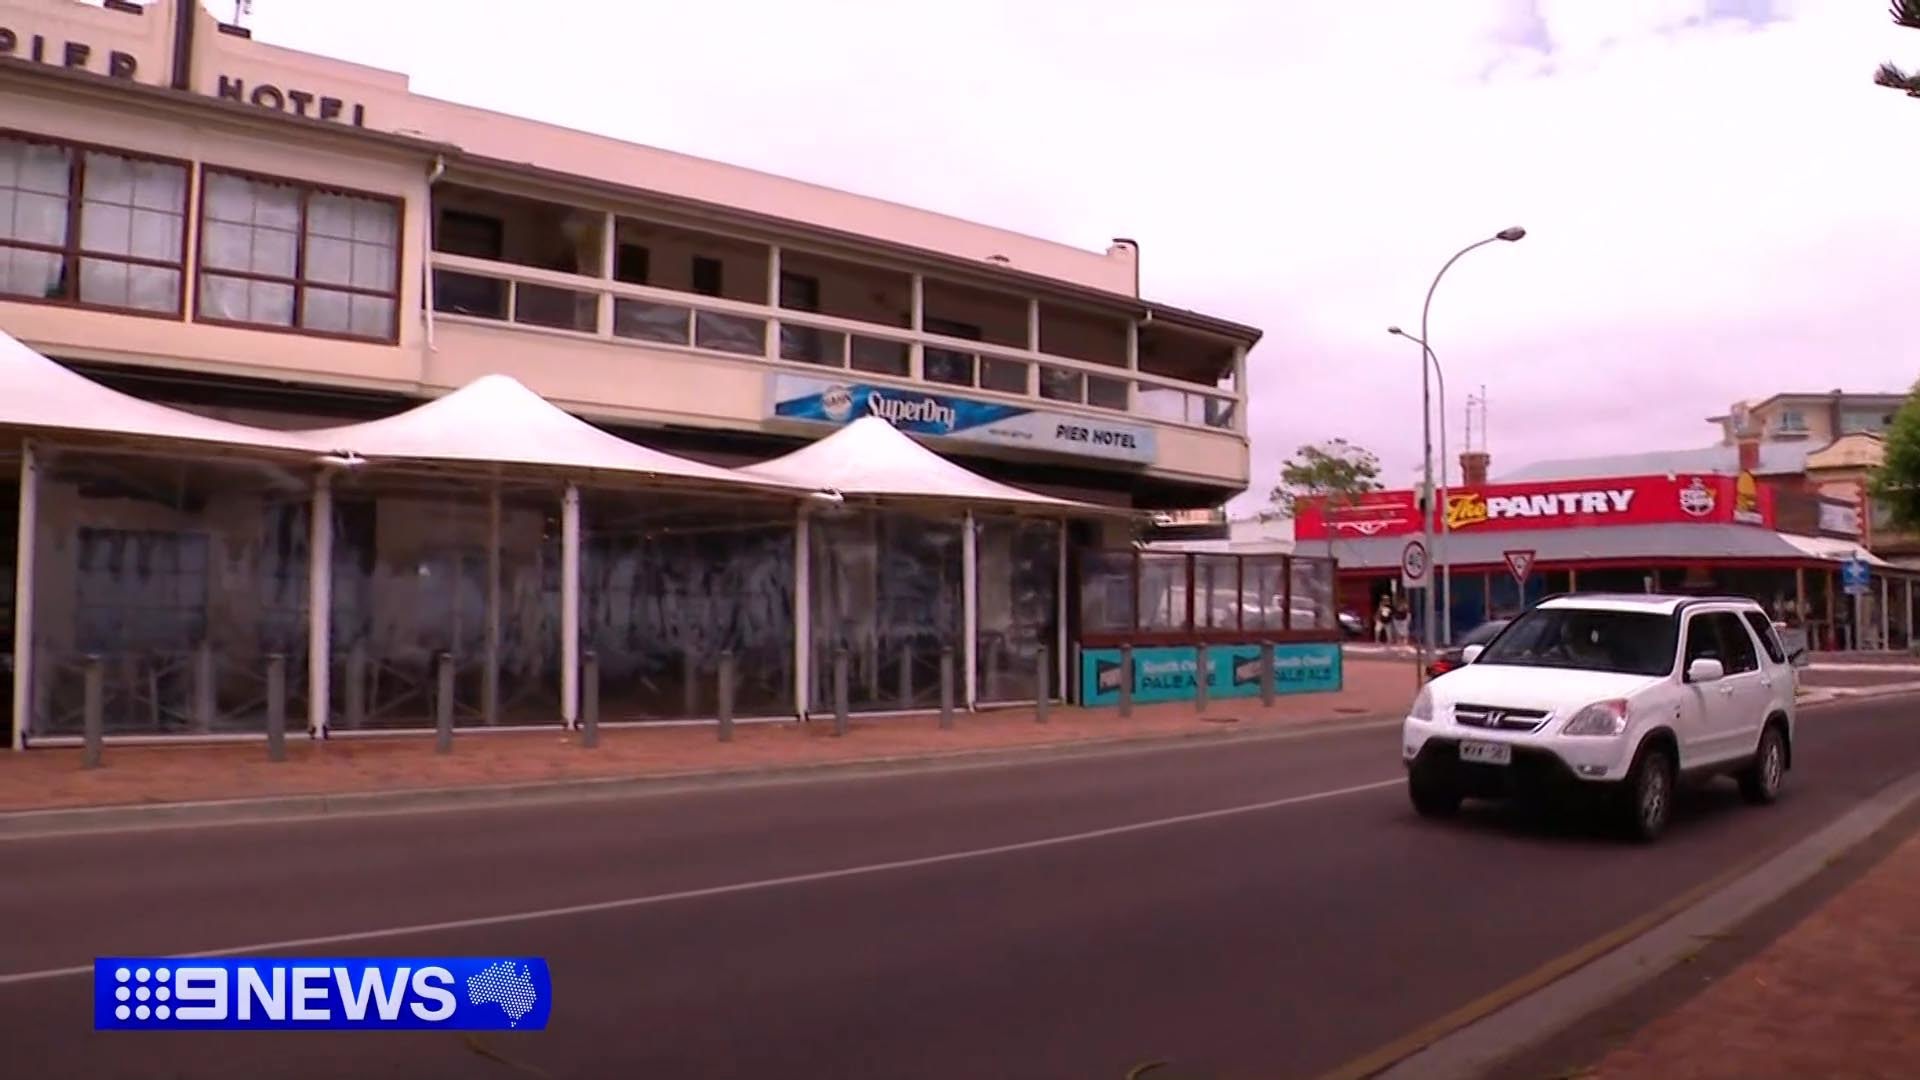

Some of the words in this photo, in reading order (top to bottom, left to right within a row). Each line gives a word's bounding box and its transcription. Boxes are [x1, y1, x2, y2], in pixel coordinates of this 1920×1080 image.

[867, 391, 955, 430] SuperDry
[1056, 424, 1089, 442] PIER
[1092, 429, 1136, 449] HOTEL
[1446, 493, 1487, 529] The
[1486, 489, 1635, 518] PANTRY
[1141, 674, 1184, 689] PALE
[1185, 671, 1217, 687] AE
[1306, 665, 1331, 680] ALE
